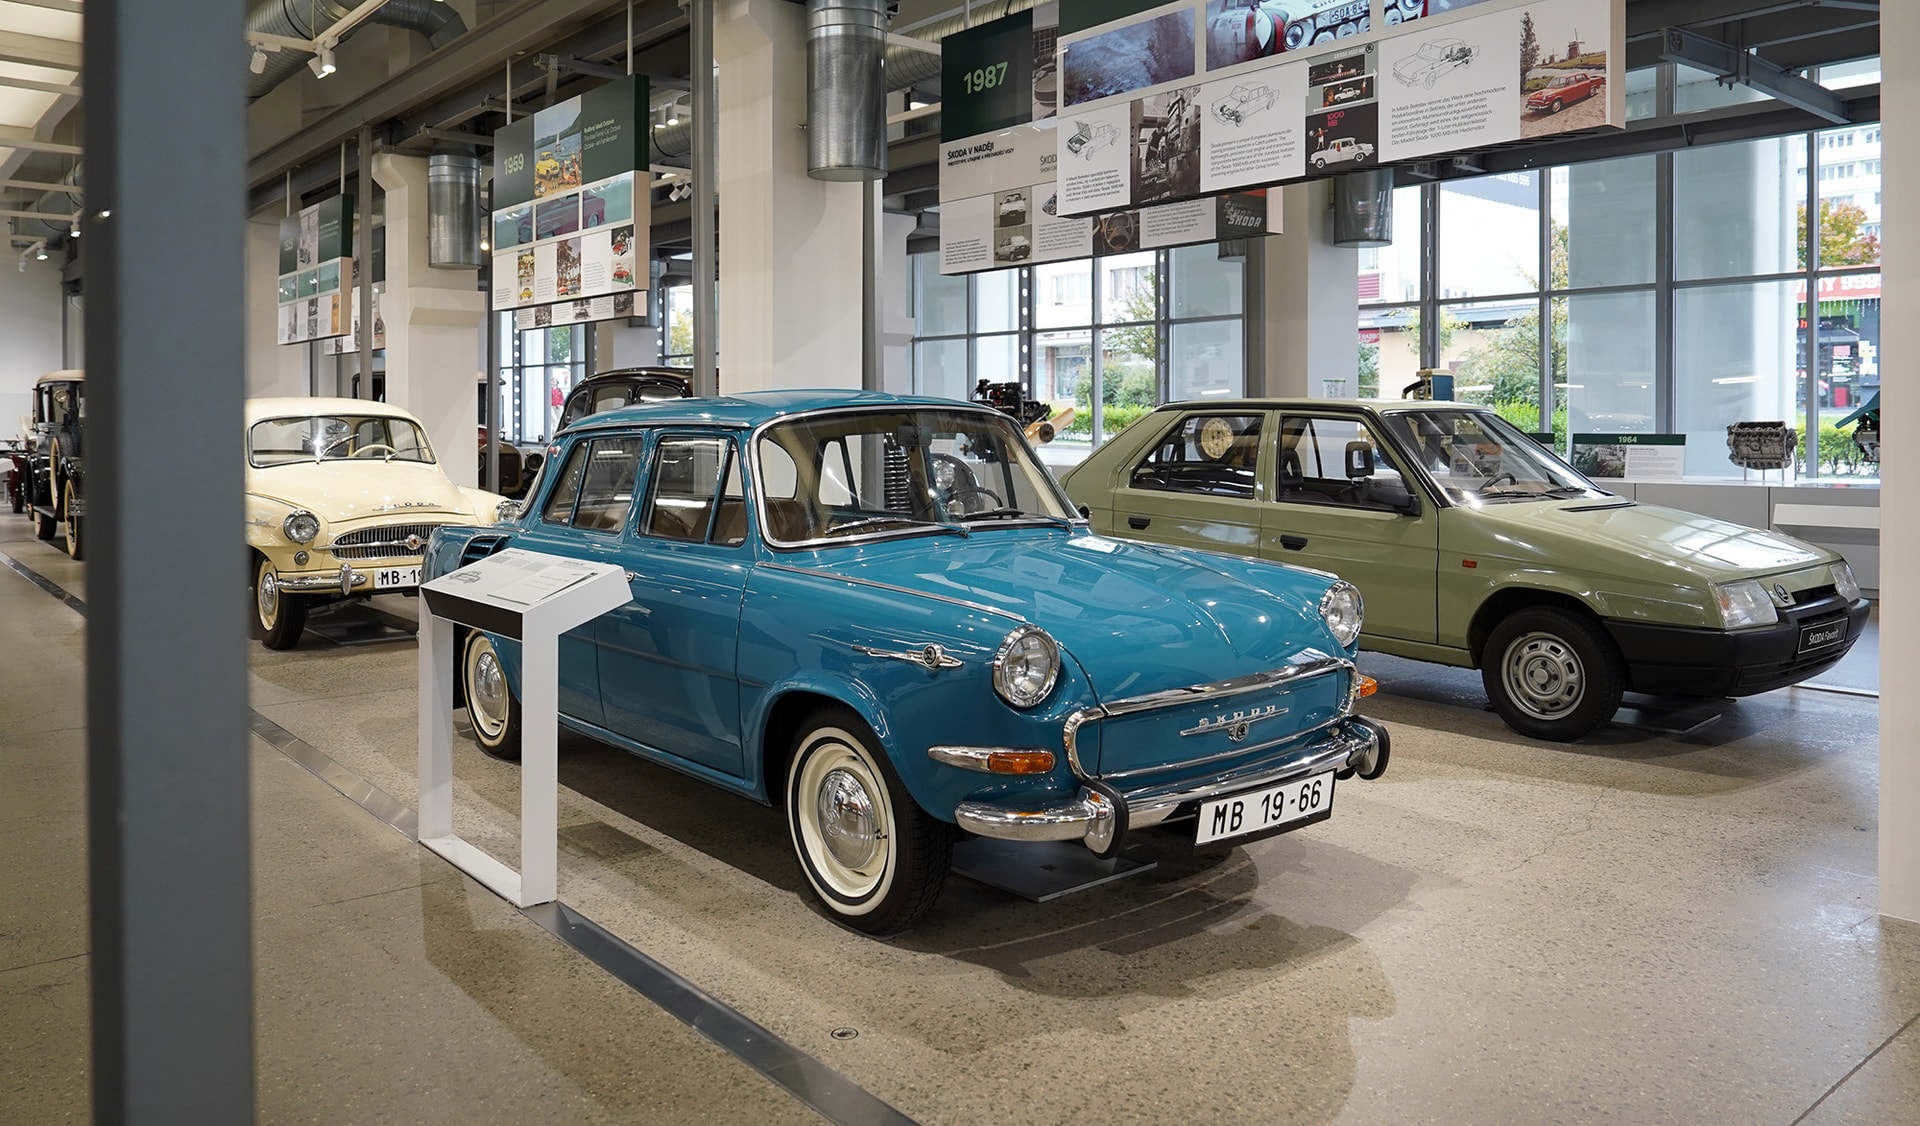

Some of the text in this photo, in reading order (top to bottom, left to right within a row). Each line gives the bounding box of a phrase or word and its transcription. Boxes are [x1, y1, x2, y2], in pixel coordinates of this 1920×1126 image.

[963, 61, 1008, 94] 1987
[1327, 111, 1344, 120] 1000
[504, 153, 524, 175] 1959
[947, 148, 967, 160] ŠKODA
[968, 146, 974, 155] V
[1212, 780, 1322, 836] MB 19-66
